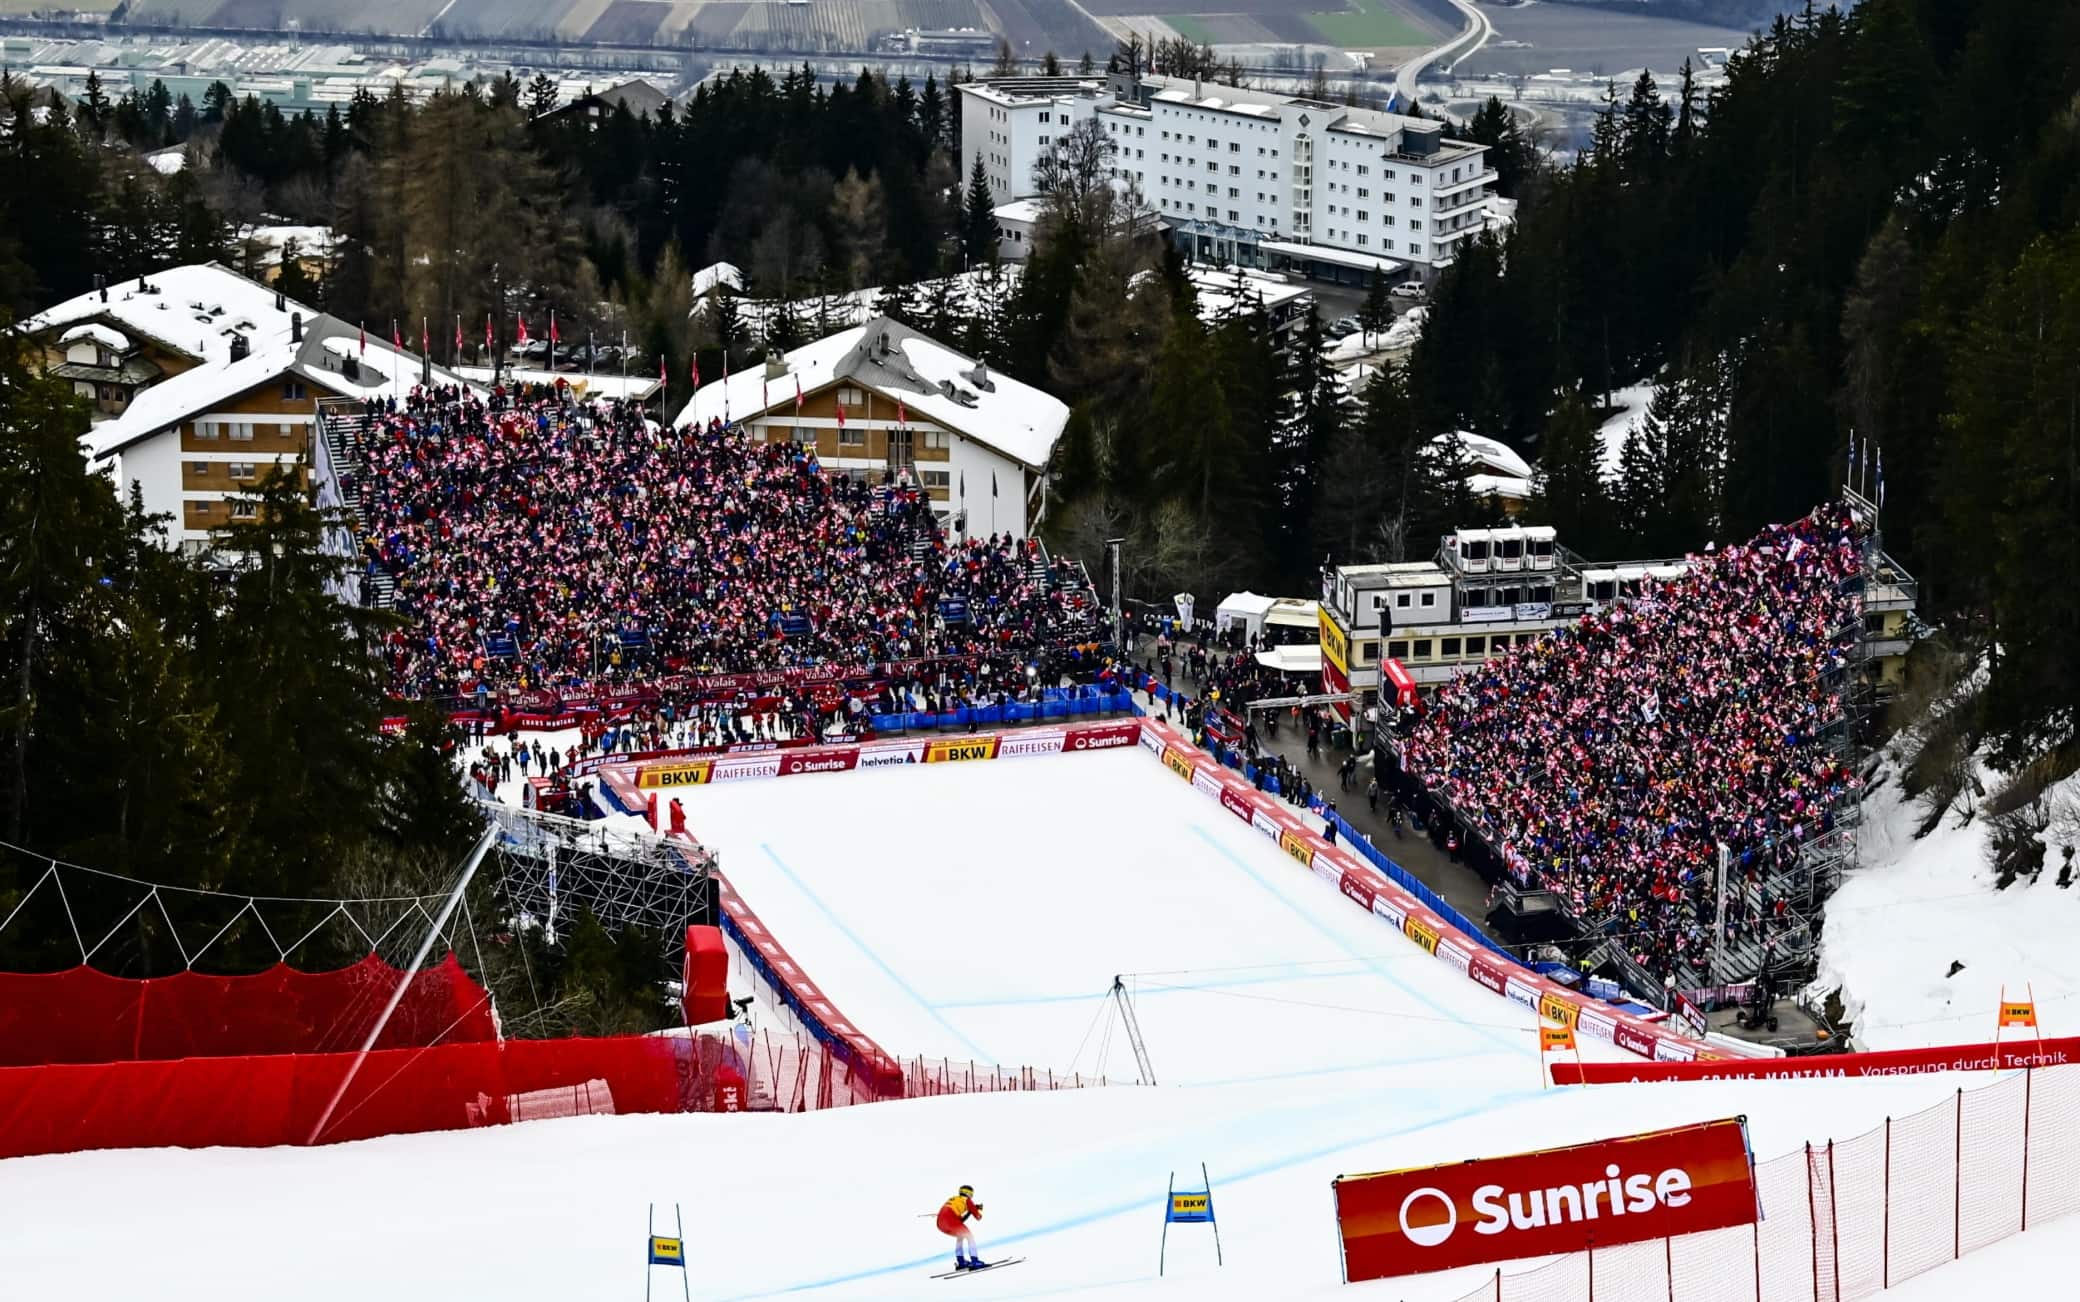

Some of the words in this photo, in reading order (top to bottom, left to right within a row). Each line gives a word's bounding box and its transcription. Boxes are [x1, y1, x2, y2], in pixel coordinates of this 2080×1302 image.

[706, 678, 737, 689] Valais
[609, 686, 639, 697] Valais
[1002, 741, 1061, 756] RAIFFEISEN
[1088, 735, 1129, 748] Sunrise
[949, 746, 986, 761] BKW
[804, 759, 846, 772] Sunrise
[861, 755, 904, 768] helvetia
[1172, 758, 1188, 777] BKW
[662, 770, 700, 785] BKW
[715, 765, 776, 780] RAIFFEISEN
[1290, 843, 1307, 864] BKW
[1414, 929, 1431, 950] BKW
[1552, 1006, 1572, 1025] BKW
[1860, 1062, 1948, 1077] Vorsprung
[1953, 1056, 2000, 1070] durch
[2005, 1051, 2068, 1067] Technik
[1183, 1199, 1206, 1208] BKW
[1472, 1163, 1692, 1236] Sunrise
